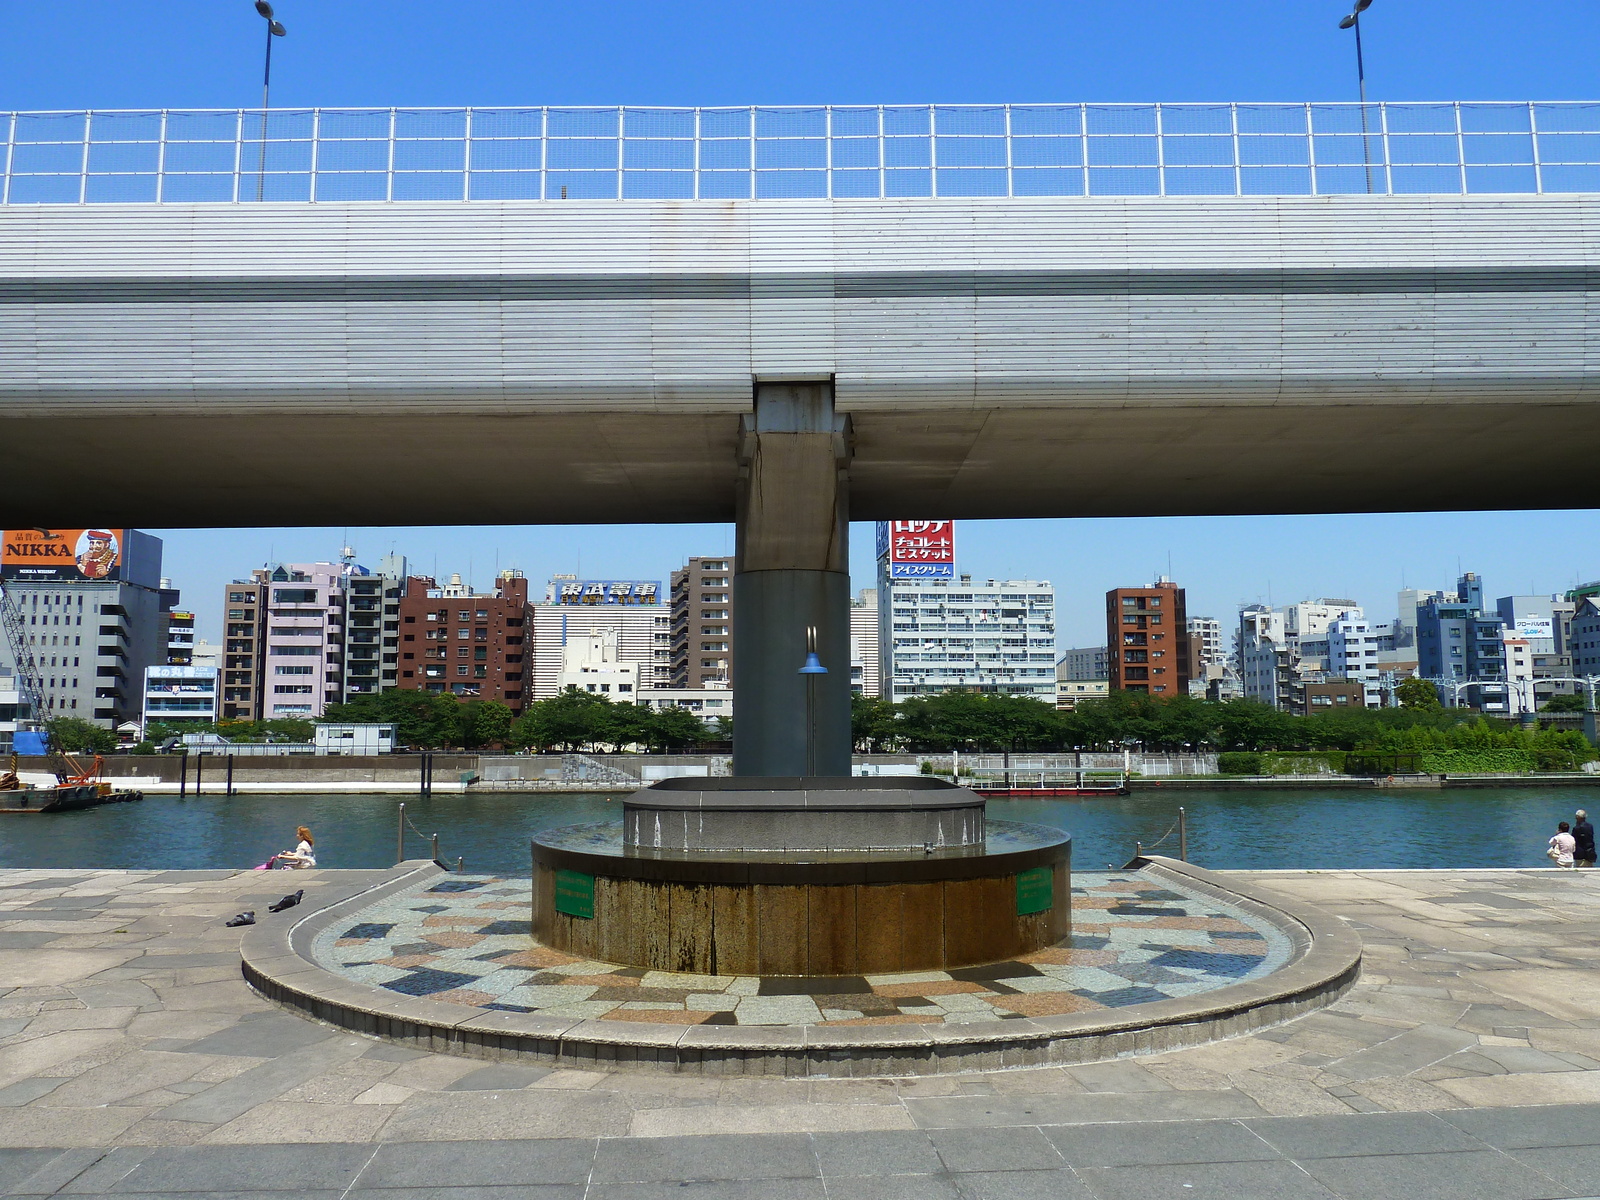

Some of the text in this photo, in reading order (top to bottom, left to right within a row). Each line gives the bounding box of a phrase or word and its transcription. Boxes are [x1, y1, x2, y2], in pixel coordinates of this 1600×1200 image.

[895, 536, 950, 547] チョコレート
[6, 544, 72, 556] NIKKA
[896, 548, 951, 559] ビスケット
[895, 565, 951, 575] アイスクリーム
[561, 582, 657, 596] 東武電車
